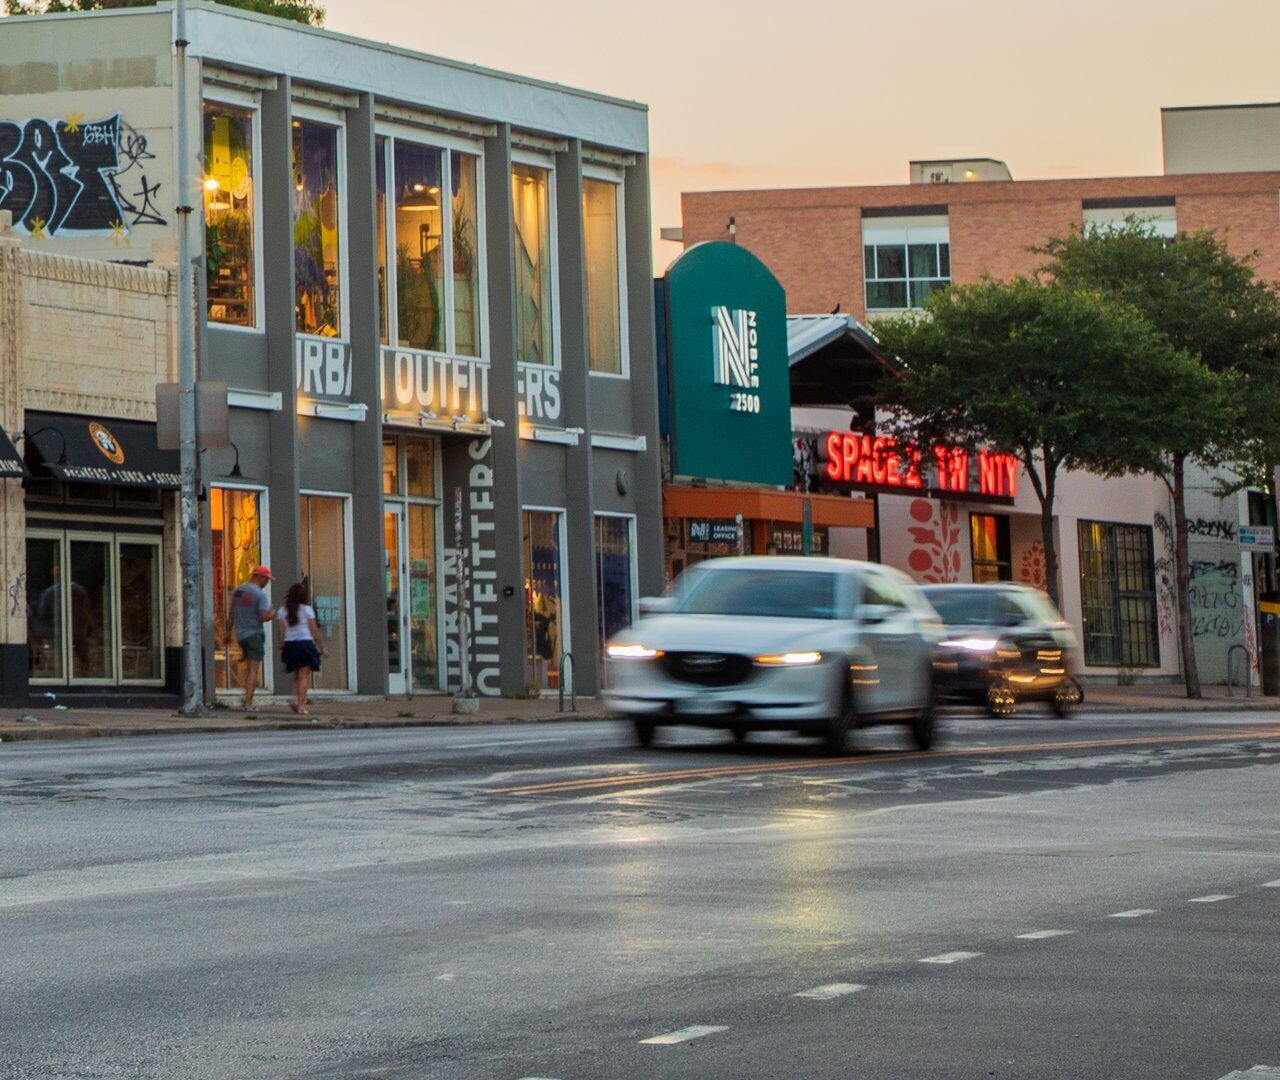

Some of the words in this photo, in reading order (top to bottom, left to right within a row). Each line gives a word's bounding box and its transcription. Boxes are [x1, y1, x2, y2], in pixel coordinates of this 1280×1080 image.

[748, 311, 760, 388] NOBLE
[736, 393, 759, 414] 2500
[118, 471, 148, 483] LUNCH
[827, 430, 901, 487] SPACE
